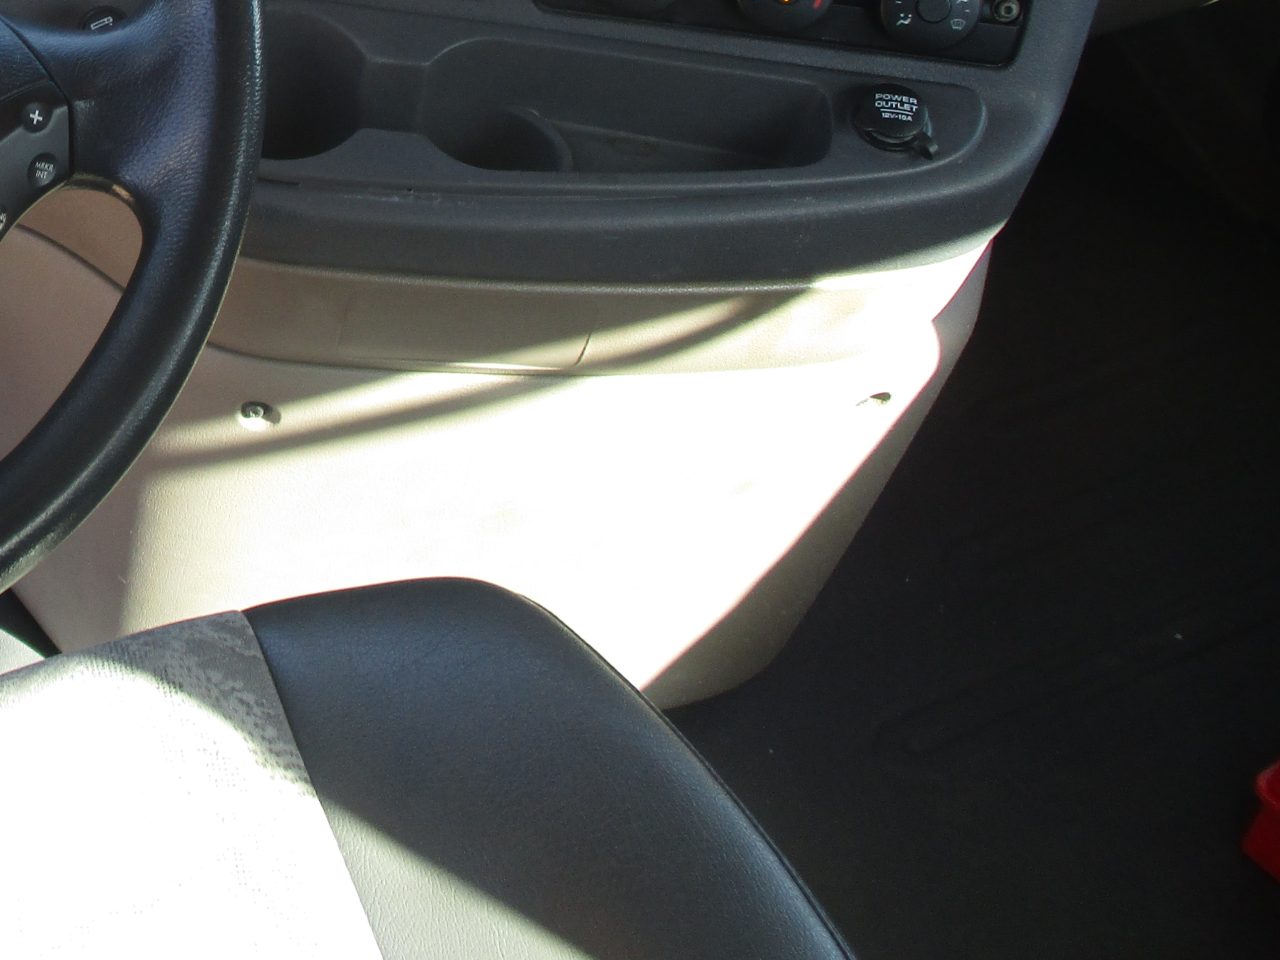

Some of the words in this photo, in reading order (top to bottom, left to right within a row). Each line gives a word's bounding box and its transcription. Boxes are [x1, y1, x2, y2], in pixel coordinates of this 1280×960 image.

[875, 93, 918, 104] POWER
[874, 100, 918, 112] OUTLET
[36, 161, 54, 172] MRKR
[36, 170, 48, 180] INT
